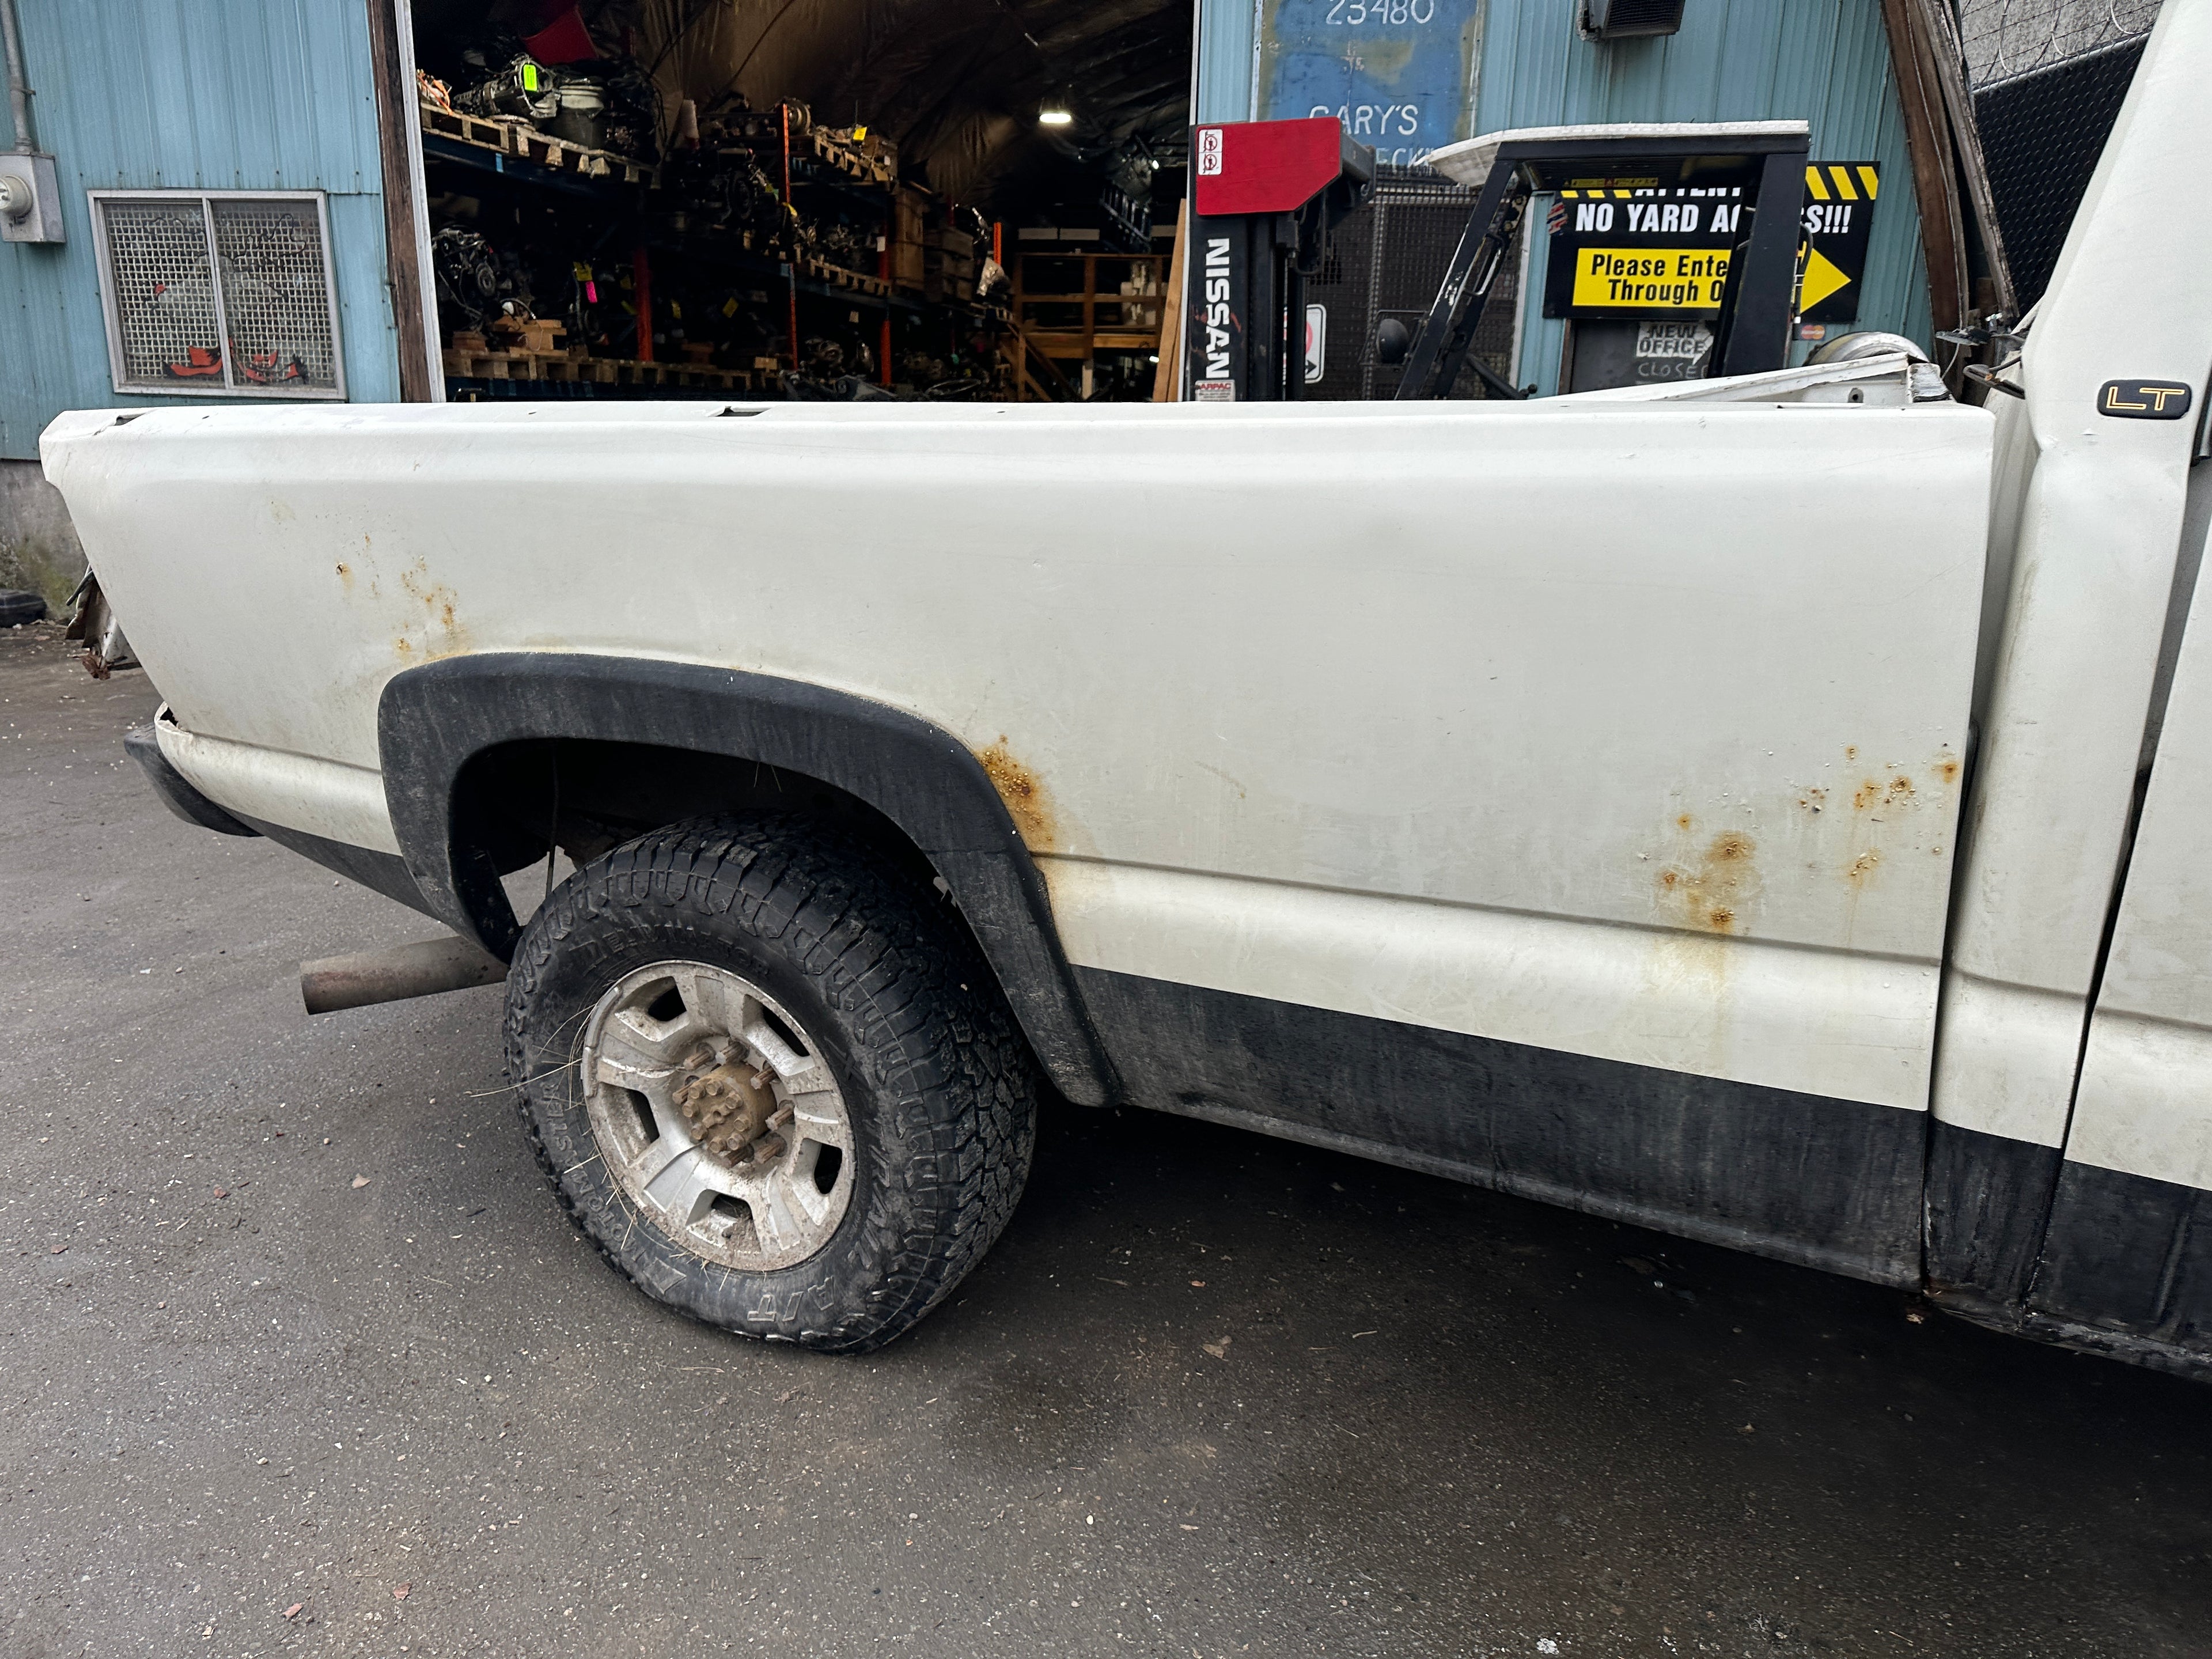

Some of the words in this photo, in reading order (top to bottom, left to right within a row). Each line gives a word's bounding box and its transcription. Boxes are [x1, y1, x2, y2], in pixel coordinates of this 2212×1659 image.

[1325, 0, 1434, 25] 23480
[1575, 203, 1613, 232] NO
[1627, 203, 1699, 232] YARD
[1591, 253, 1665, 276] Please
[1676, 255, 1728, 276] Ente
[1608, 278, 1699, 305] Through
[1205, 237, 1230, 379] NISSAN
[1650, 324, 1696, 339] NEW
[1639, 336, 1706, 354] OFFICE
[2105, 386, 2186, 411] LT
[747, 1275, 835, 1323] A/T
